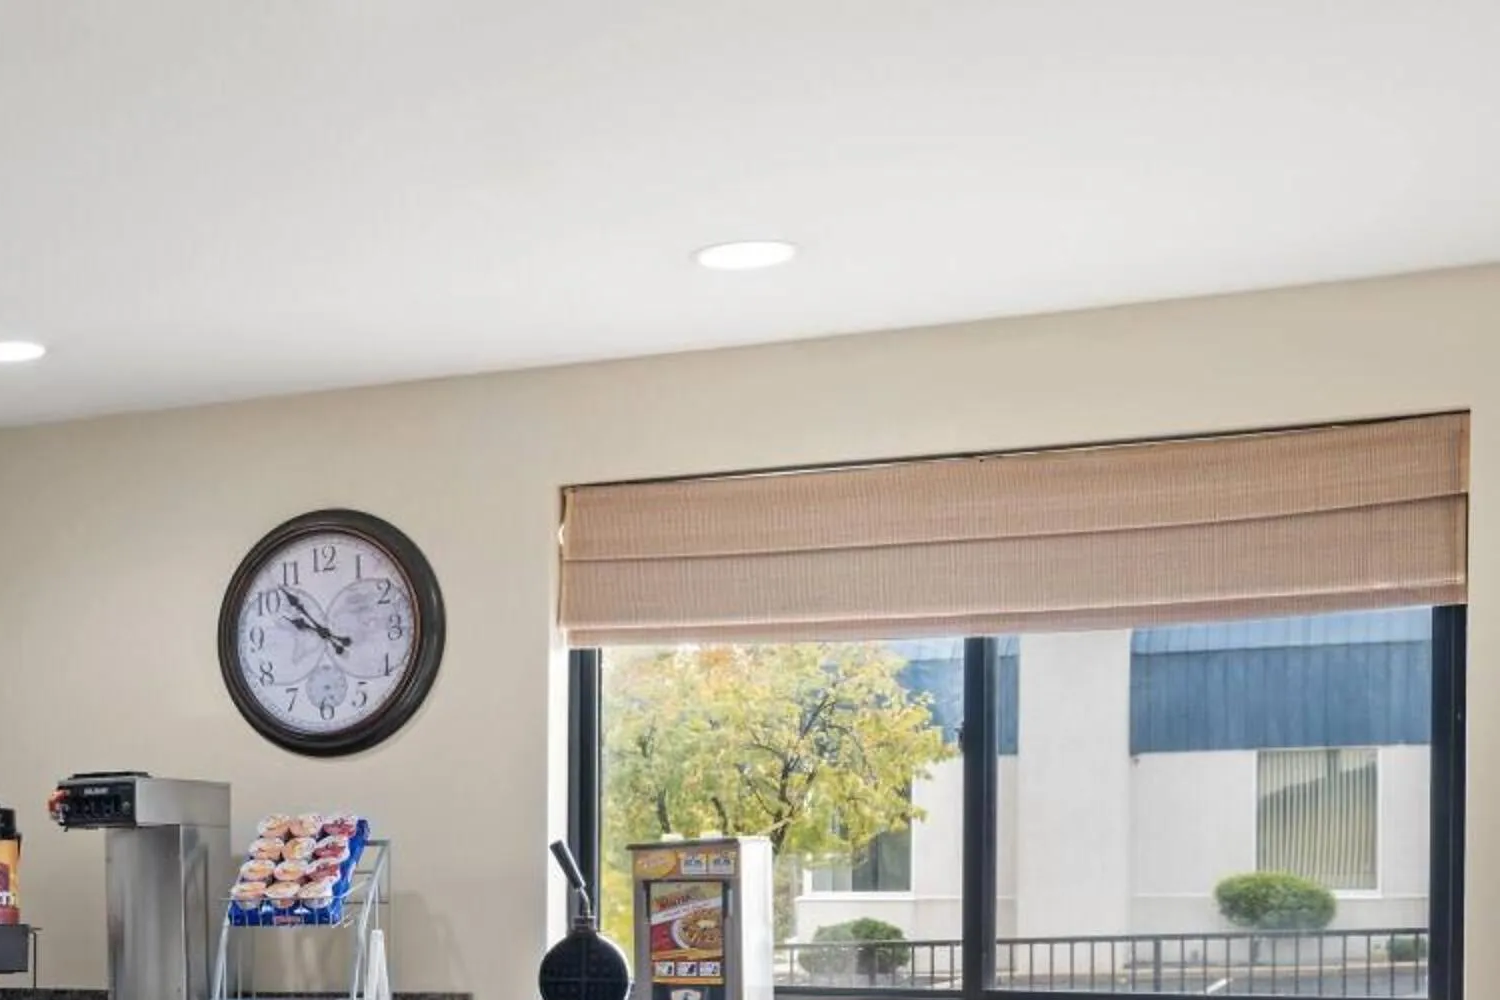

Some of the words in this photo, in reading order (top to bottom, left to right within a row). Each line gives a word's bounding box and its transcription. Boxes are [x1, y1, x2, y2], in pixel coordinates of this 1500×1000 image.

[312, 545, 337, 574] 12
[355, 554, 362, 580] 1
[283, 561, 299, 587] 11
[256, 591, 281, 617] 10
[376, 578, 392, 605] 2
[250, 626, 265, 653] 9
[387, 613, 403, 641] 3
[259, 661, 275, 687] 8
[285, 687, 299, 712] 7
[352, 681, 368, 709] 5
[319, 697, 335, 720] 6
